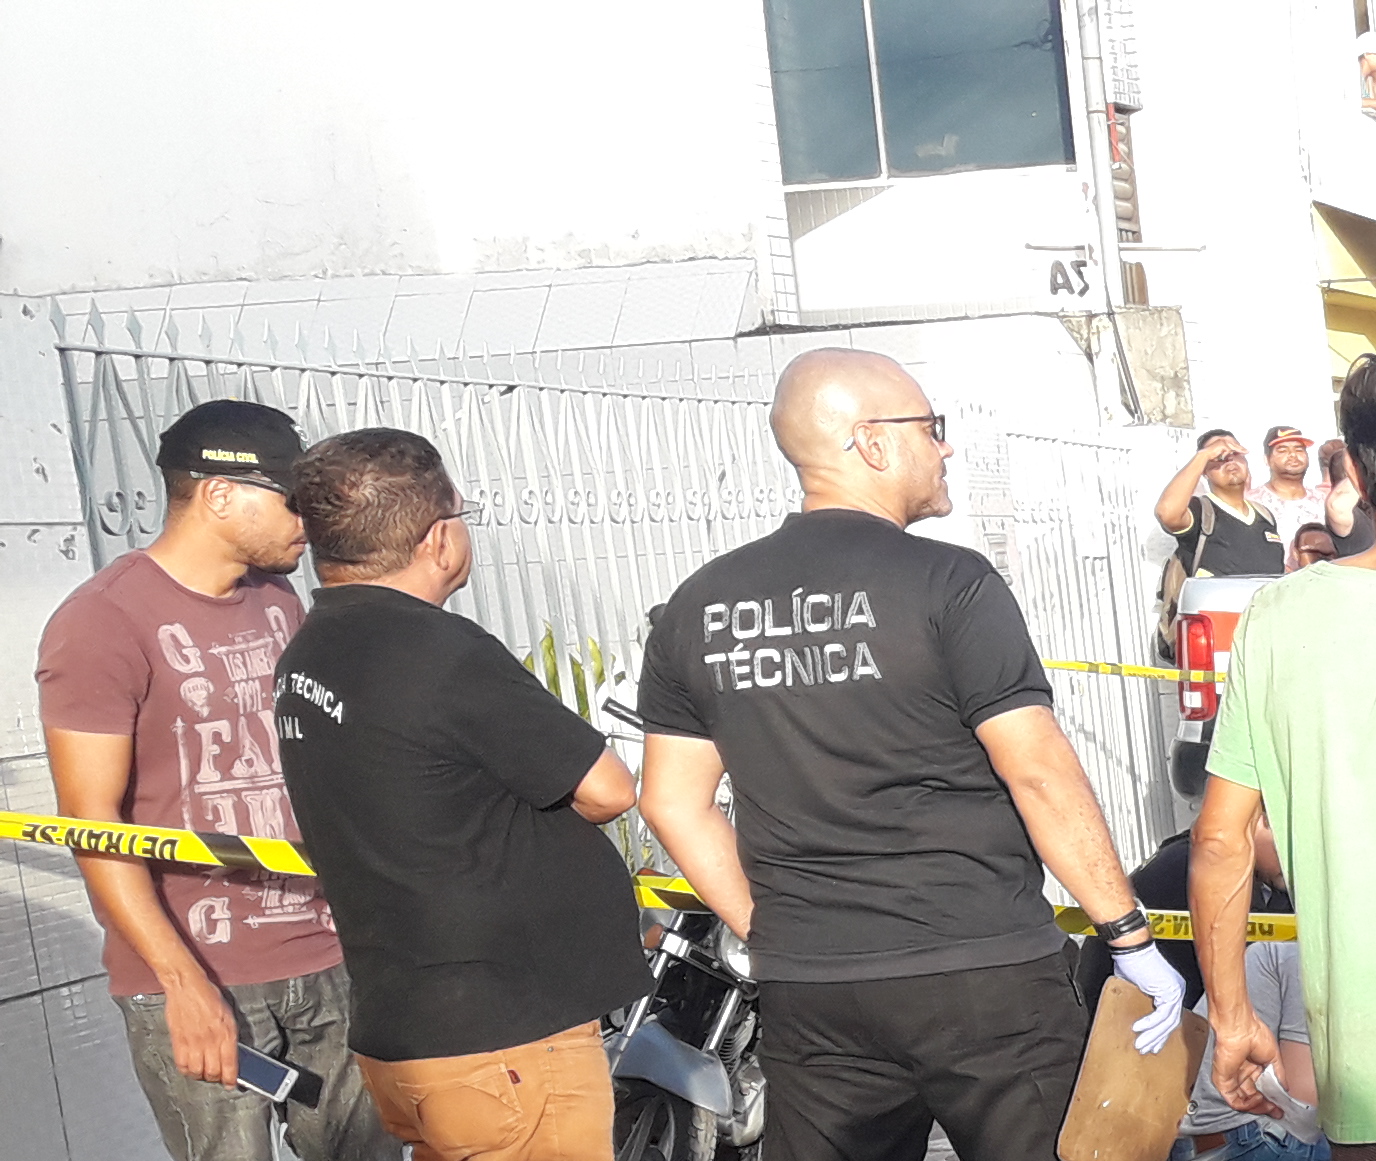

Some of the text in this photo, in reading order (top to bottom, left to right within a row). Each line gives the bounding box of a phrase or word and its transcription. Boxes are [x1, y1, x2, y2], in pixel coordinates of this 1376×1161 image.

[704, 587, 877, 643] POLÍCIA
[704, 642, 883, 693] TÉCNICA
[290, 671, 344, 725] TÉCNICA
[21, 823, 179, 861] DETRAN-SE
